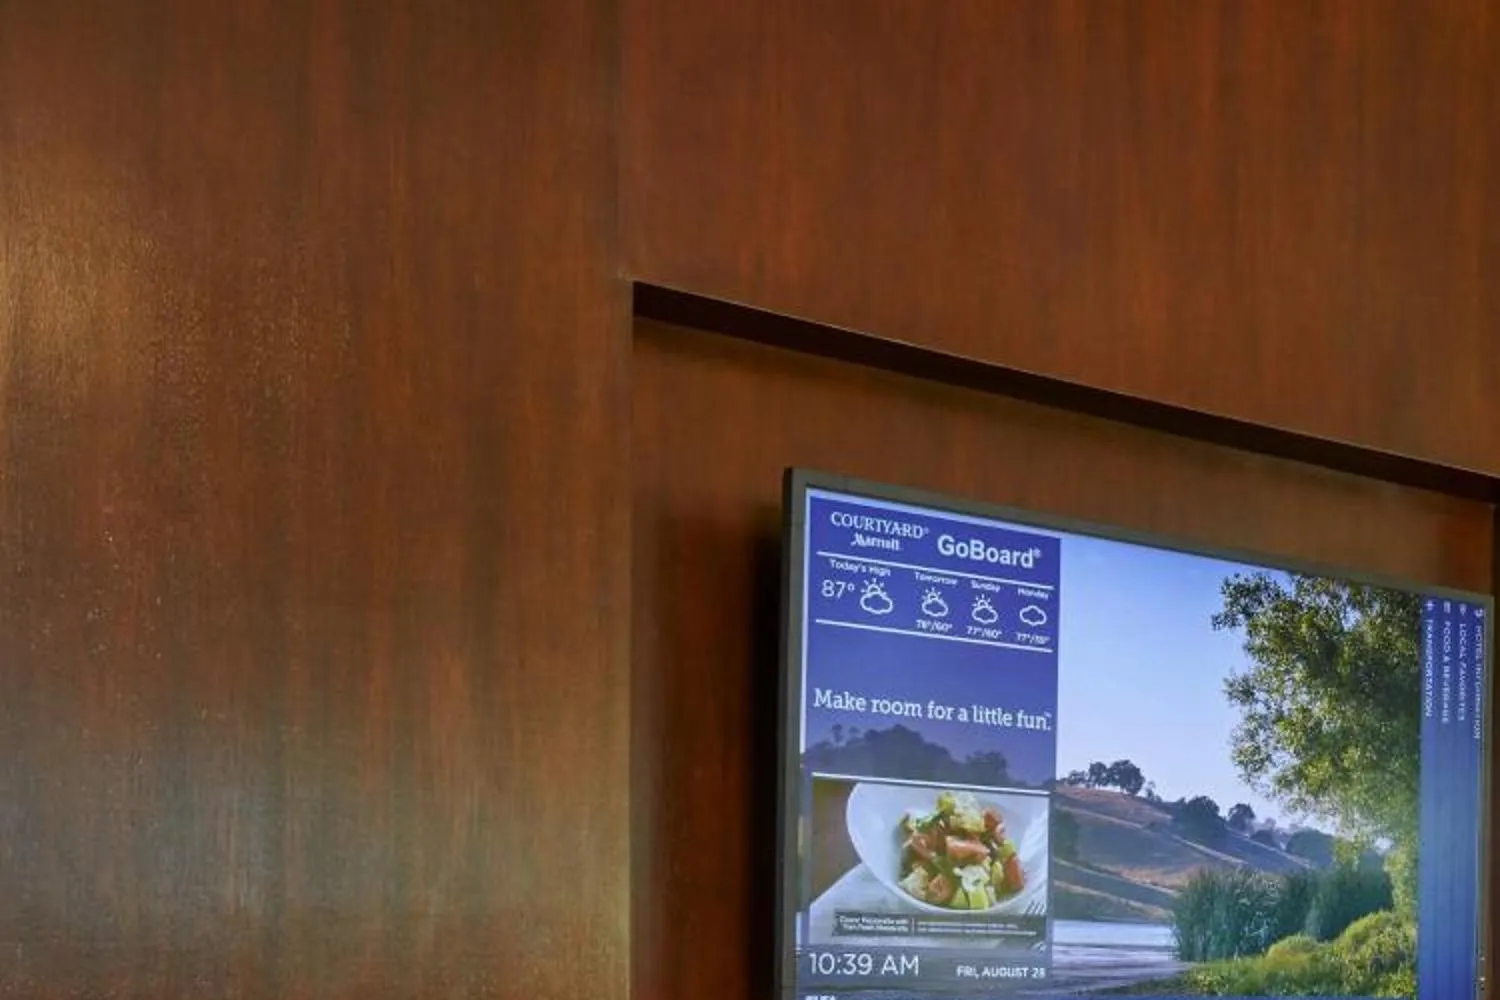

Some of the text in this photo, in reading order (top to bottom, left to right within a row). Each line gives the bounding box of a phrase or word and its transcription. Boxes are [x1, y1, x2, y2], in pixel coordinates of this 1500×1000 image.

[830, 559, 868, 574] Today's
[915, 571, 958, 587] Tomorrow
[971, 580, 1001, 593] Sunday
[1443, 621, 1451, 652] FOOD
[1459, 623, 1467, 658] LOCAL
[1475, 625, 1483, 660] HOTEL
[1425, 619, 1434, 717] TRANSPORTATION
[813, 688, 866, 712] Make
[871, 698, 922, 718] room
[927, 700, 953, 721] for
[957, 708, 969, 722] a
[972, 705, 1013, 727] little
[809, 952, 919, 976] 10:39 AM
[957, 965, 979, 979] FRI,
[981, 966, 1028, 978] AUGUST
